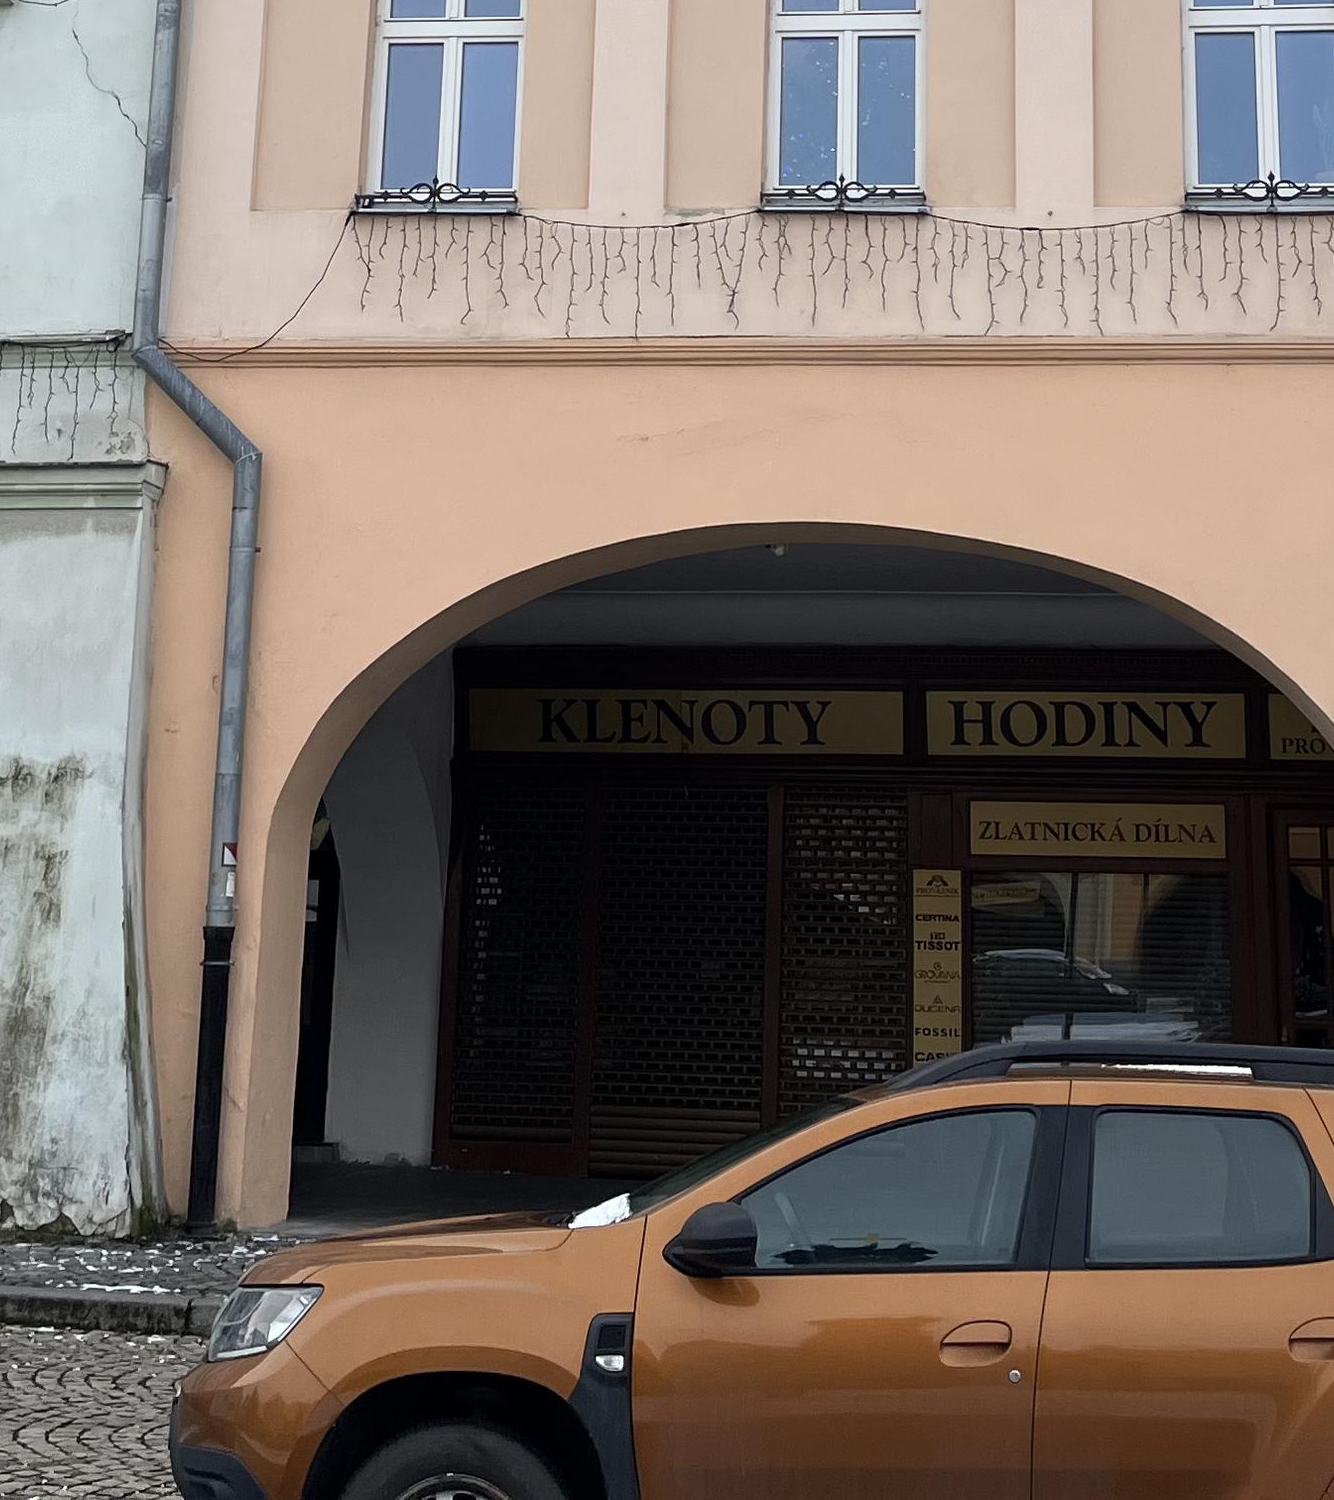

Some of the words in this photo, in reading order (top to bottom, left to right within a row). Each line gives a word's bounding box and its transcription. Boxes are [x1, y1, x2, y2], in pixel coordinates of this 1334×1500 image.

[536, 697, 833, 746] KLENOTY
[947, 699, 1217, 749] HODINY
[978, 818, 1127, 844] ZLATNICKÁ
[1133, 817, 1217, 845] DÍLNA
[915, 914, 960, 923] CERTINA
[915, 940, 961, 951] TISSOT
[915, 1027, 961, 1037] FOSSIL
